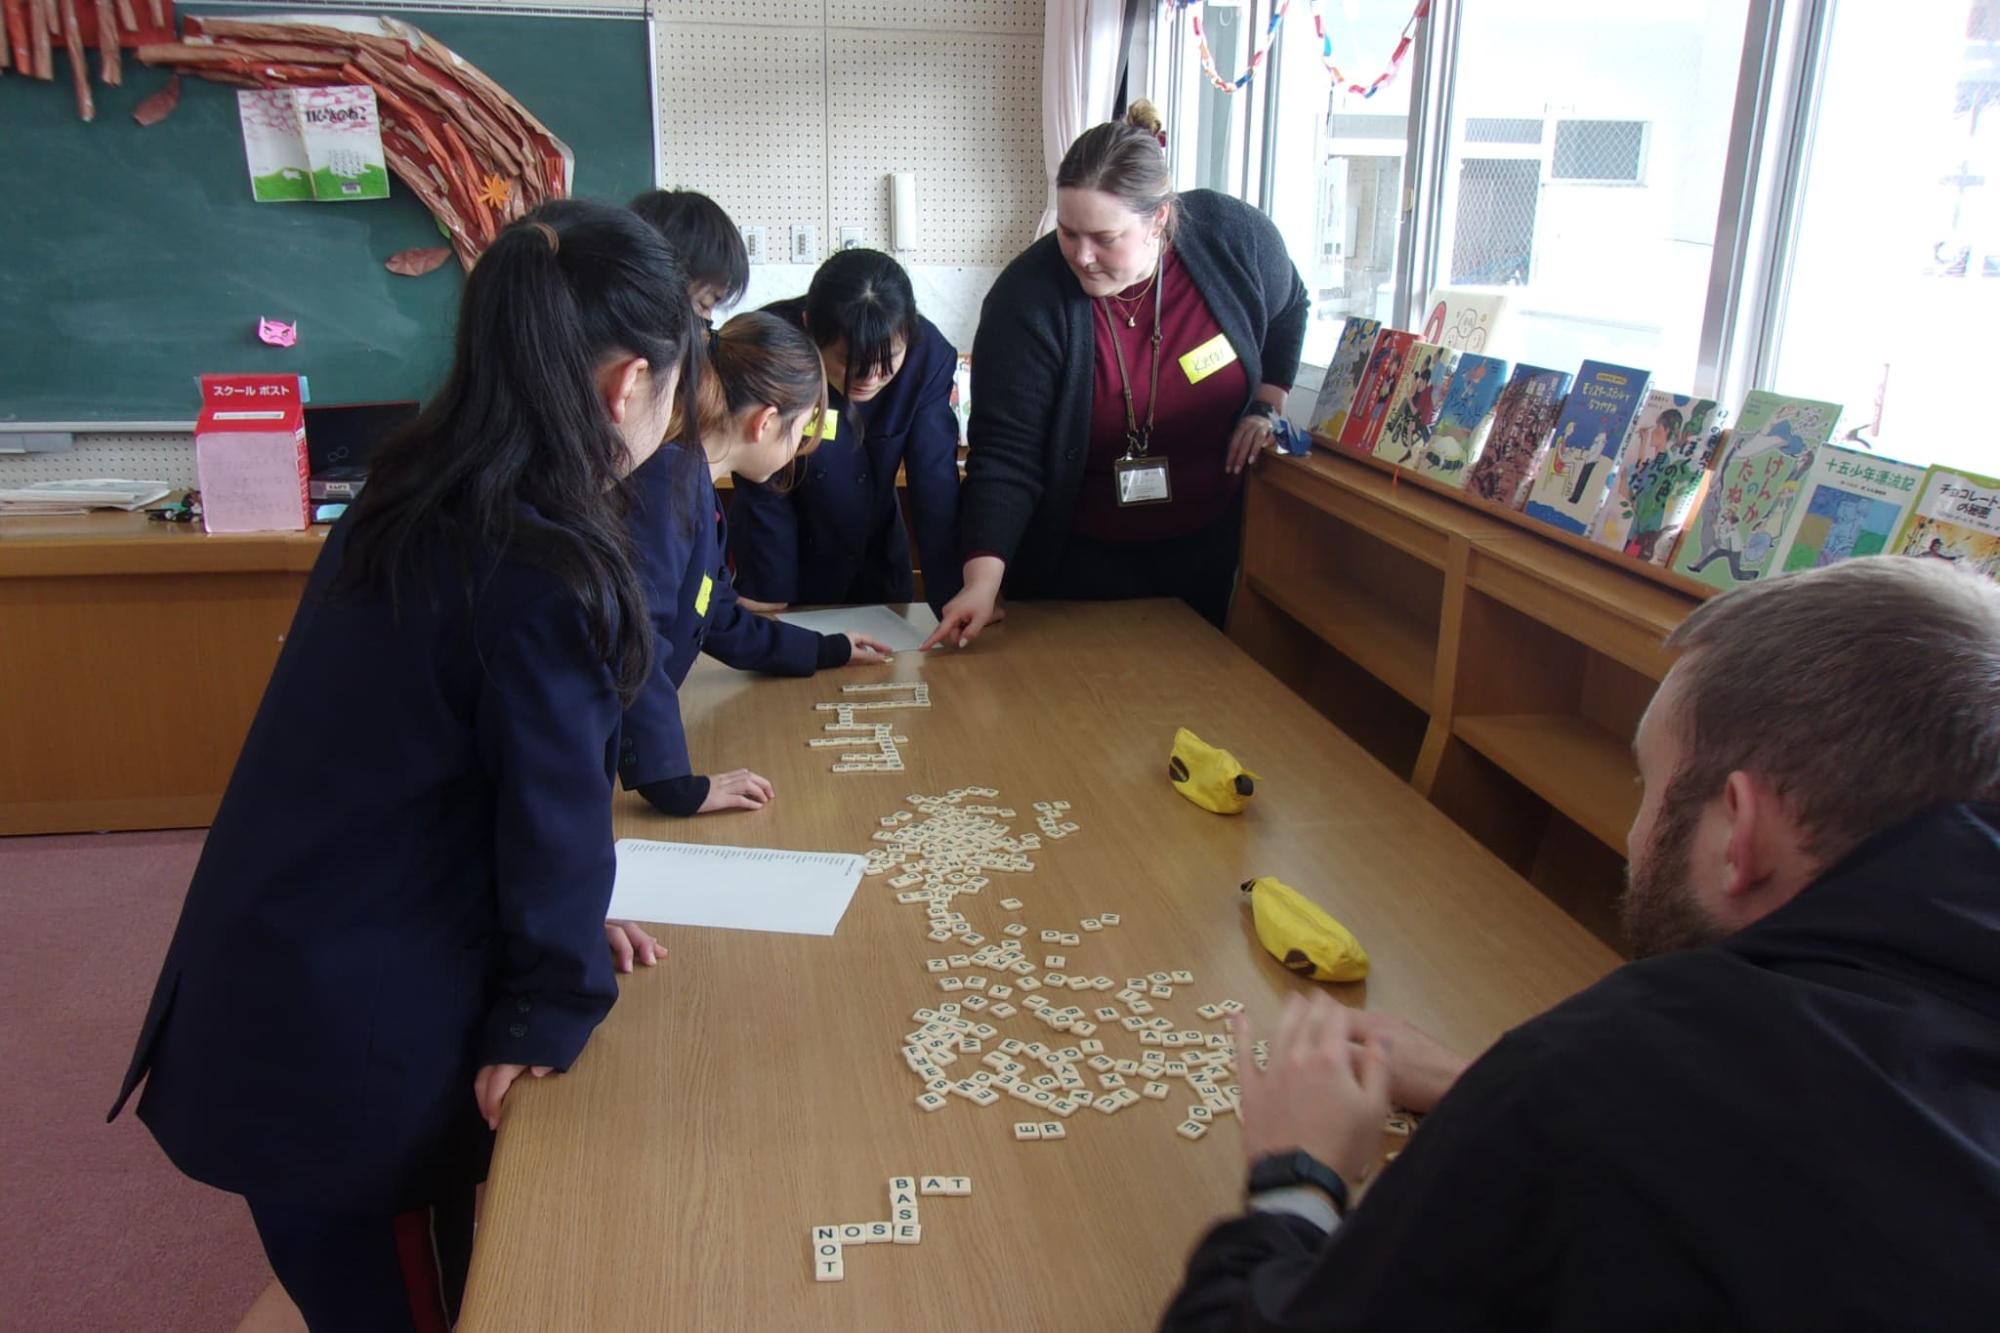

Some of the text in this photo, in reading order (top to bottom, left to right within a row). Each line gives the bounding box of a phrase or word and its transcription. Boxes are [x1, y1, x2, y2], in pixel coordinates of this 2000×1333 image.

[213, 386, 289, 396] スクール ポスト
[1940, 484, 1998, 506] チョコレート
[896, 1179, 963, 1189] BAT
[896, 1179, 915, 1236] BASE
[818, 1225, 915, 1239] NOSE
[818, 1228, 837, 1272] NOT
